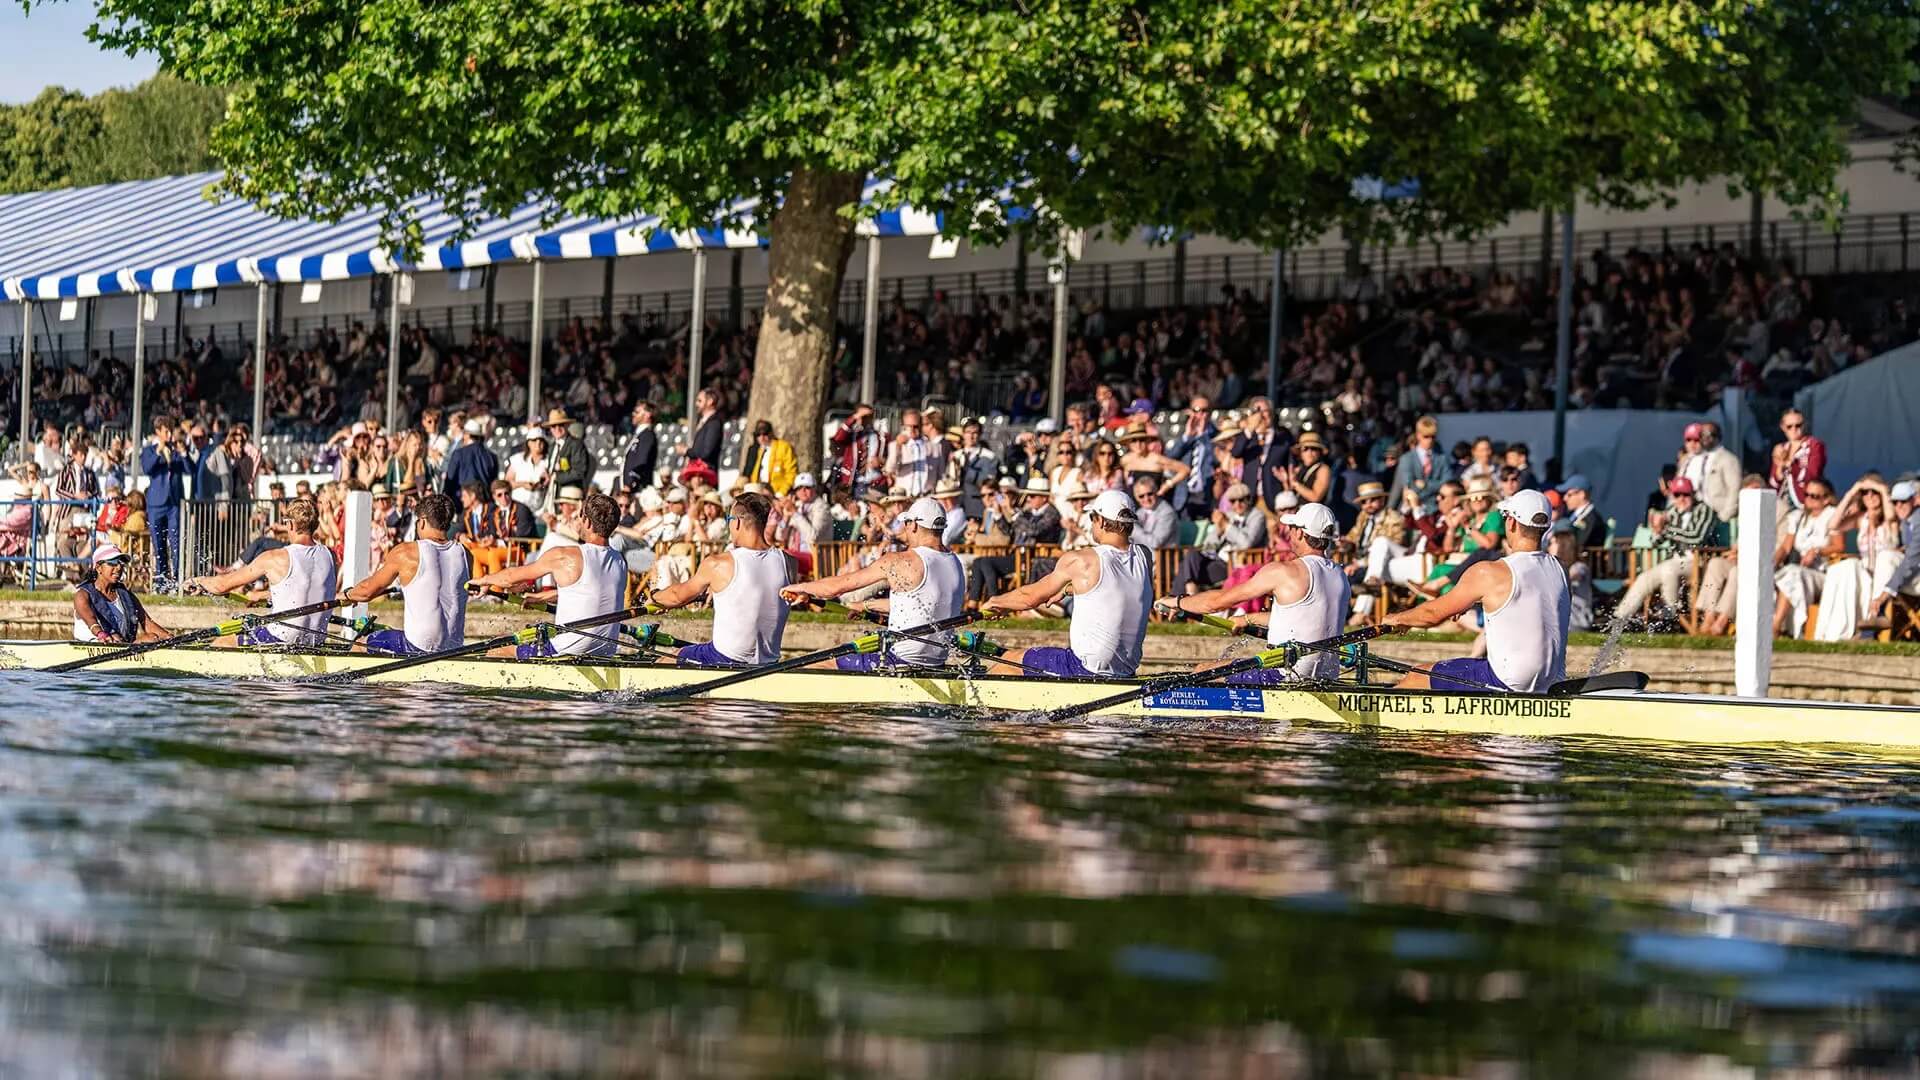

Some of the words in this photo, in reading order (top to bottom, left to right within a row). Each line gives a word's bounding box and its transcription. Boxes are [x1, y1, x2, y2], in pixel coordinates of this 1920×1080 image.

[1159, 697, 1179, 705] ROYAL
[1181, 698, 1209, 706] REGATTA
[1337, 694, 1416, 713] MICHAEL
[1422, 696, 1435, 714] S.
[1444, 697, 1571, 718] LAFROMBOISE
